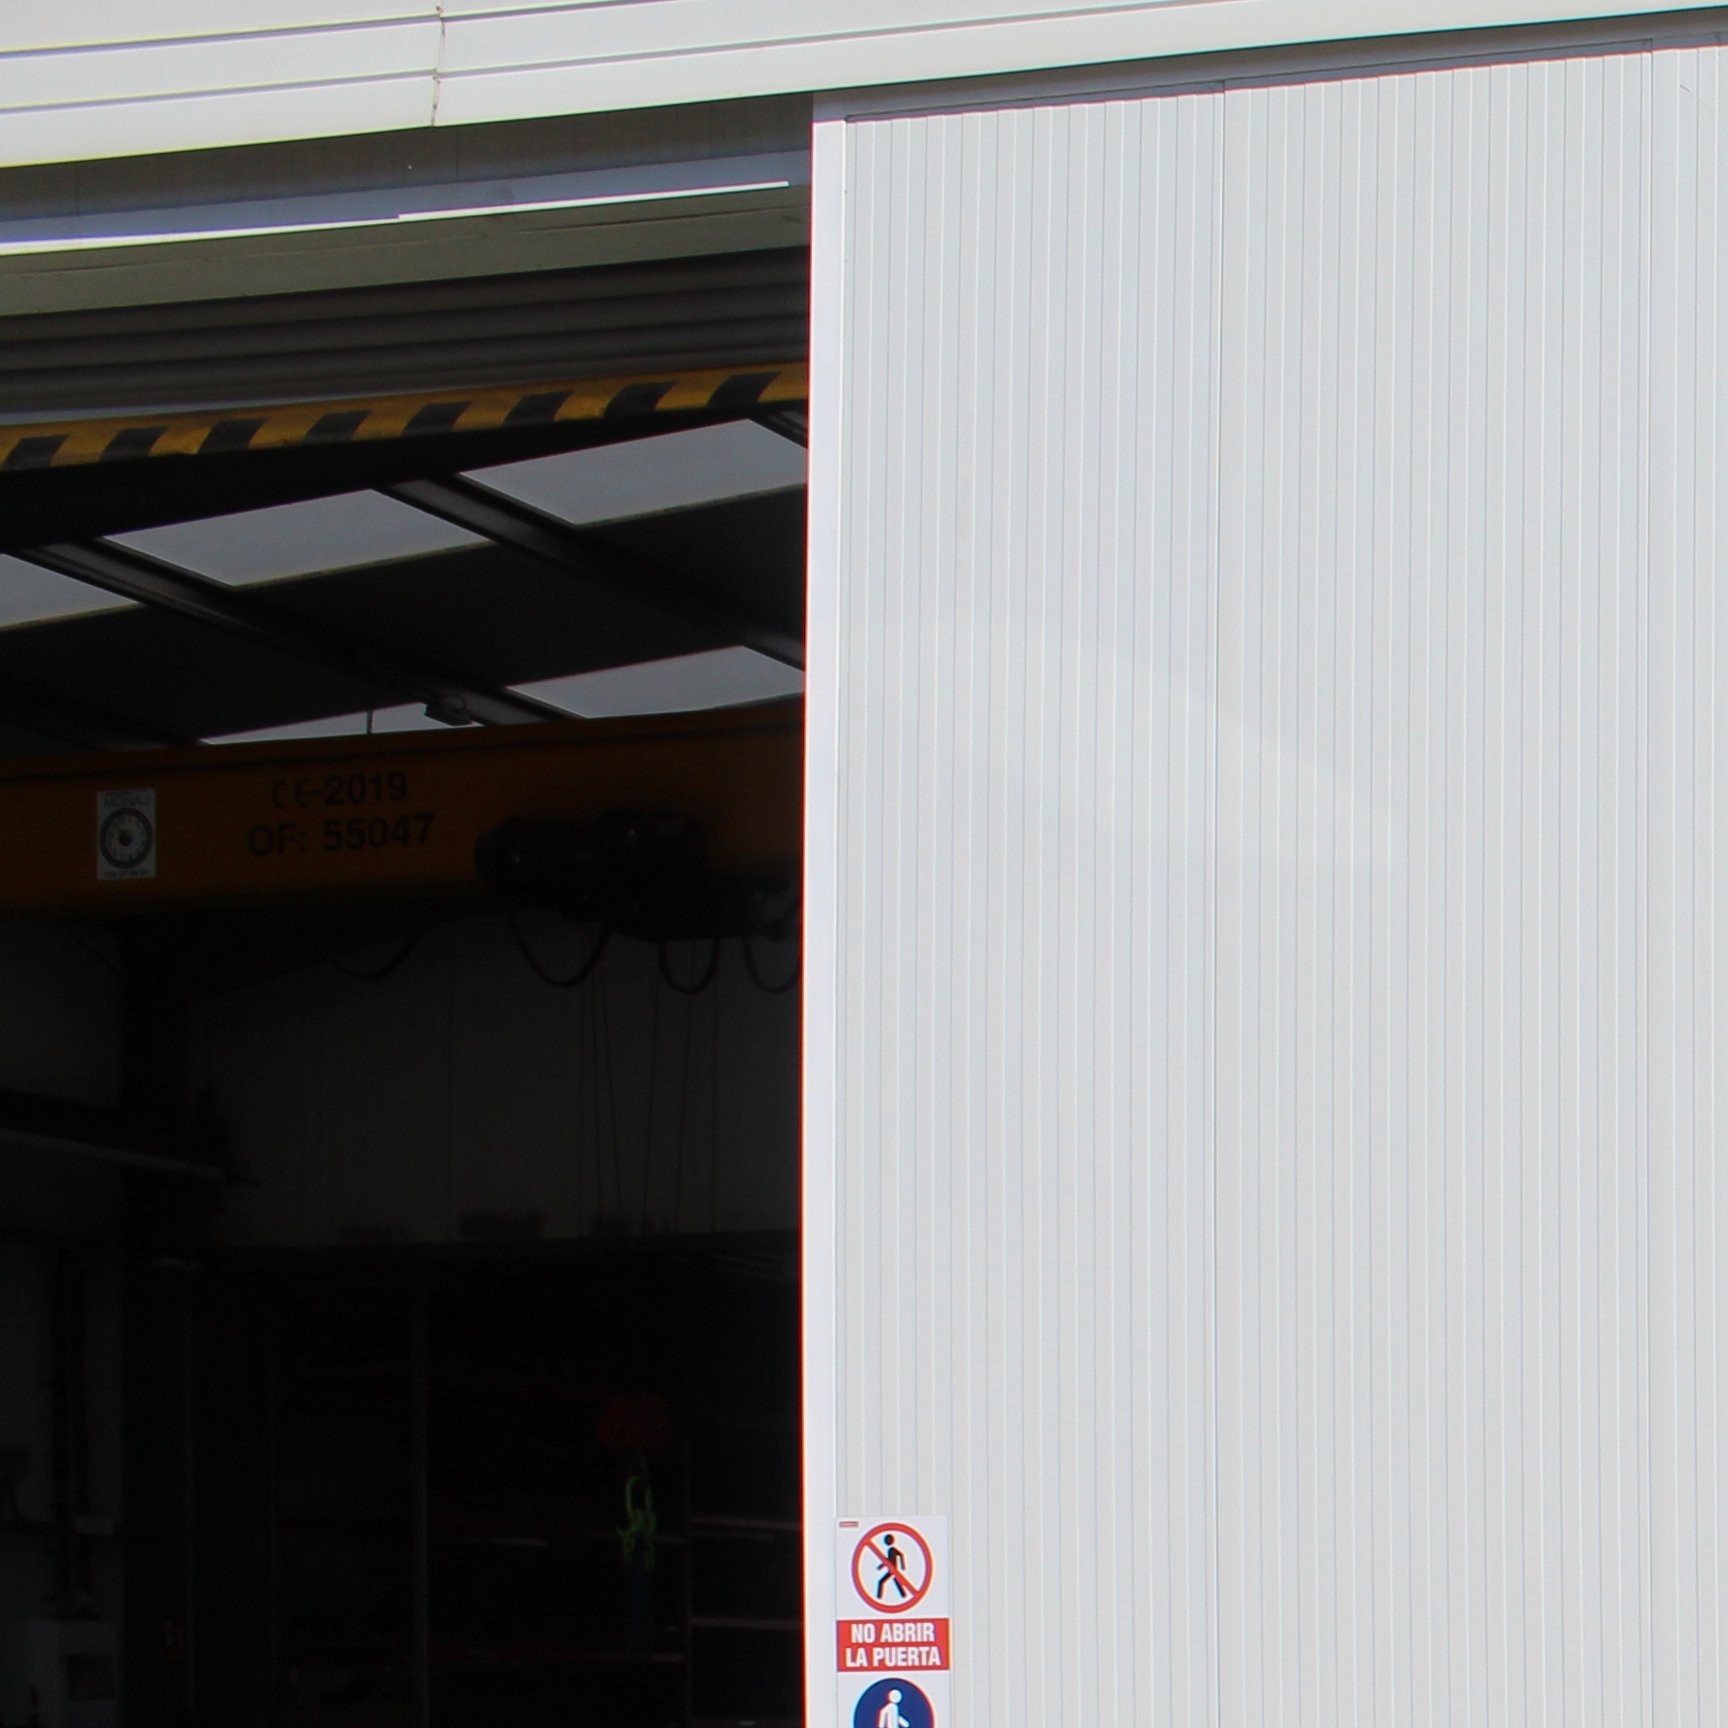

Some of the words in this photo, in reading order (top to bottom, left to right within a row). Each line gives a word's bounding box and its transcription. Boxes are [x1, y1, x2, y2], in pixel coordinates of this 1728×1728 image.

[248, 822, 306, 856] OF:
[322, 810, 435, 852] 55047
[850, 1622, 876, 1643] NO
[880, 1621, 935, 1643] ABRIR
[845, 1647, 868, 1668] LA
[873, 1646, 940, 1667] PUERTA
